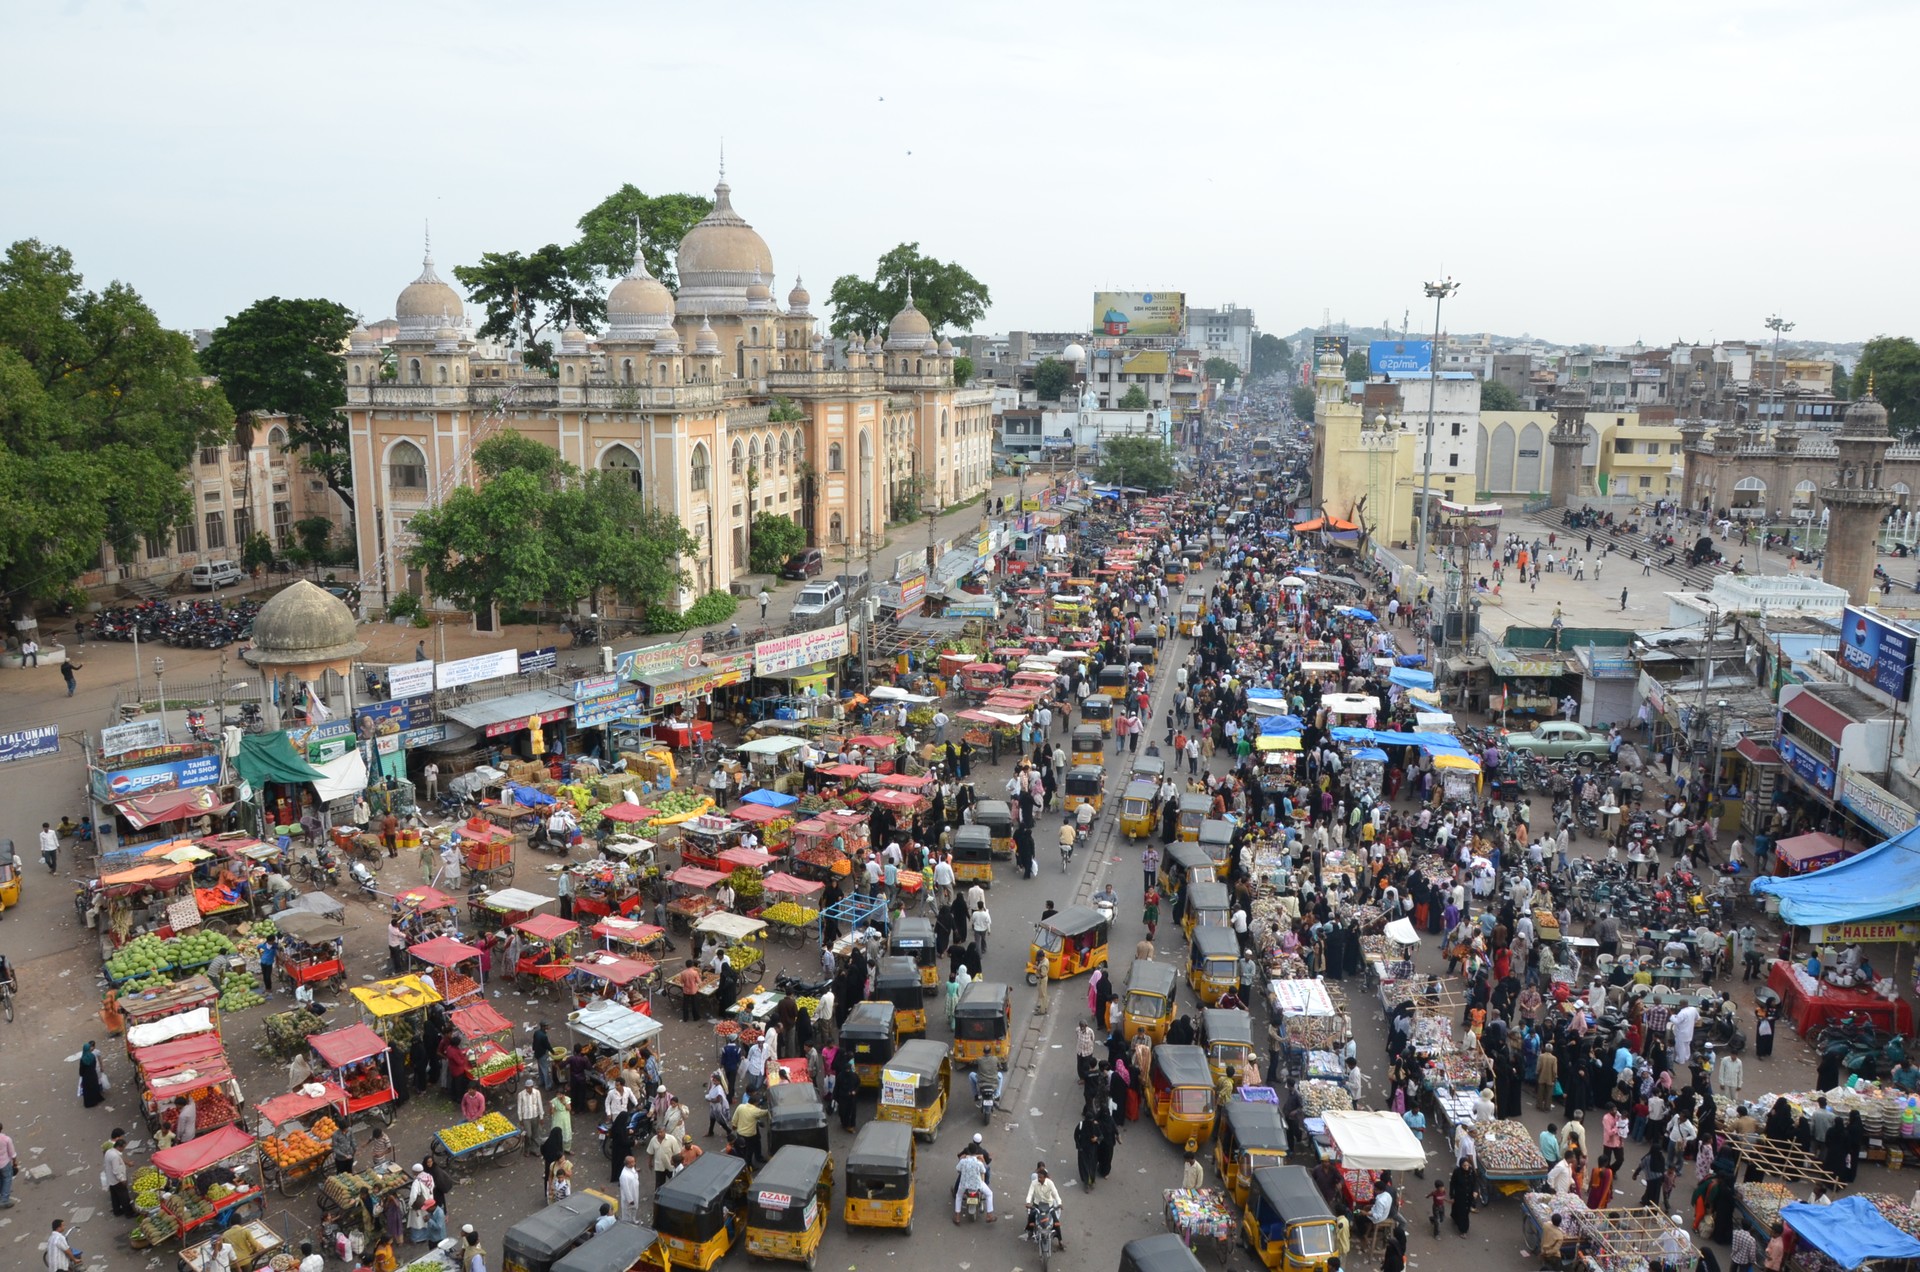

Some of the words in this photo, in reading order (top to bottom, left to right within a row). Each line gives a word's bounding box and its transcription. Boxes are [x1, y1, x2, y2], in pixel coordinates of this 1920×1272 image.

[757, 641, 786, 657] MUQADDAR
[787, 637, 802, 650] HOTEL
[1885, 634, 1903, 648] NIMRAH
[636, 646, 686, 665] ROSHAN
[1844, 643, 1872, 669] PEPSI
[1879, 643, 1889, 653] CAFE
[1891, 649, 1907, 662] BAKERY
[480, 661, 499, 669] COLLEGE
[640, 661, 661, 671] CHICKEN
[695, 672, 714, 683] HOUSE
[618, 689, 636, 697] BAKERY
[319, 723, 350, 738] NEEDS
[412, 731, 444, 745] PEPSI
[182, 769, 197, 777] PAN
[198, 765, 217, 775] SHOP
[187, 760, 212, 769] TAHER
[132, 771, 173, 787] PEPSI
[1843, 926, 1896, 938] HALEEM
[760, 1191, 790, 1202] AZAM
